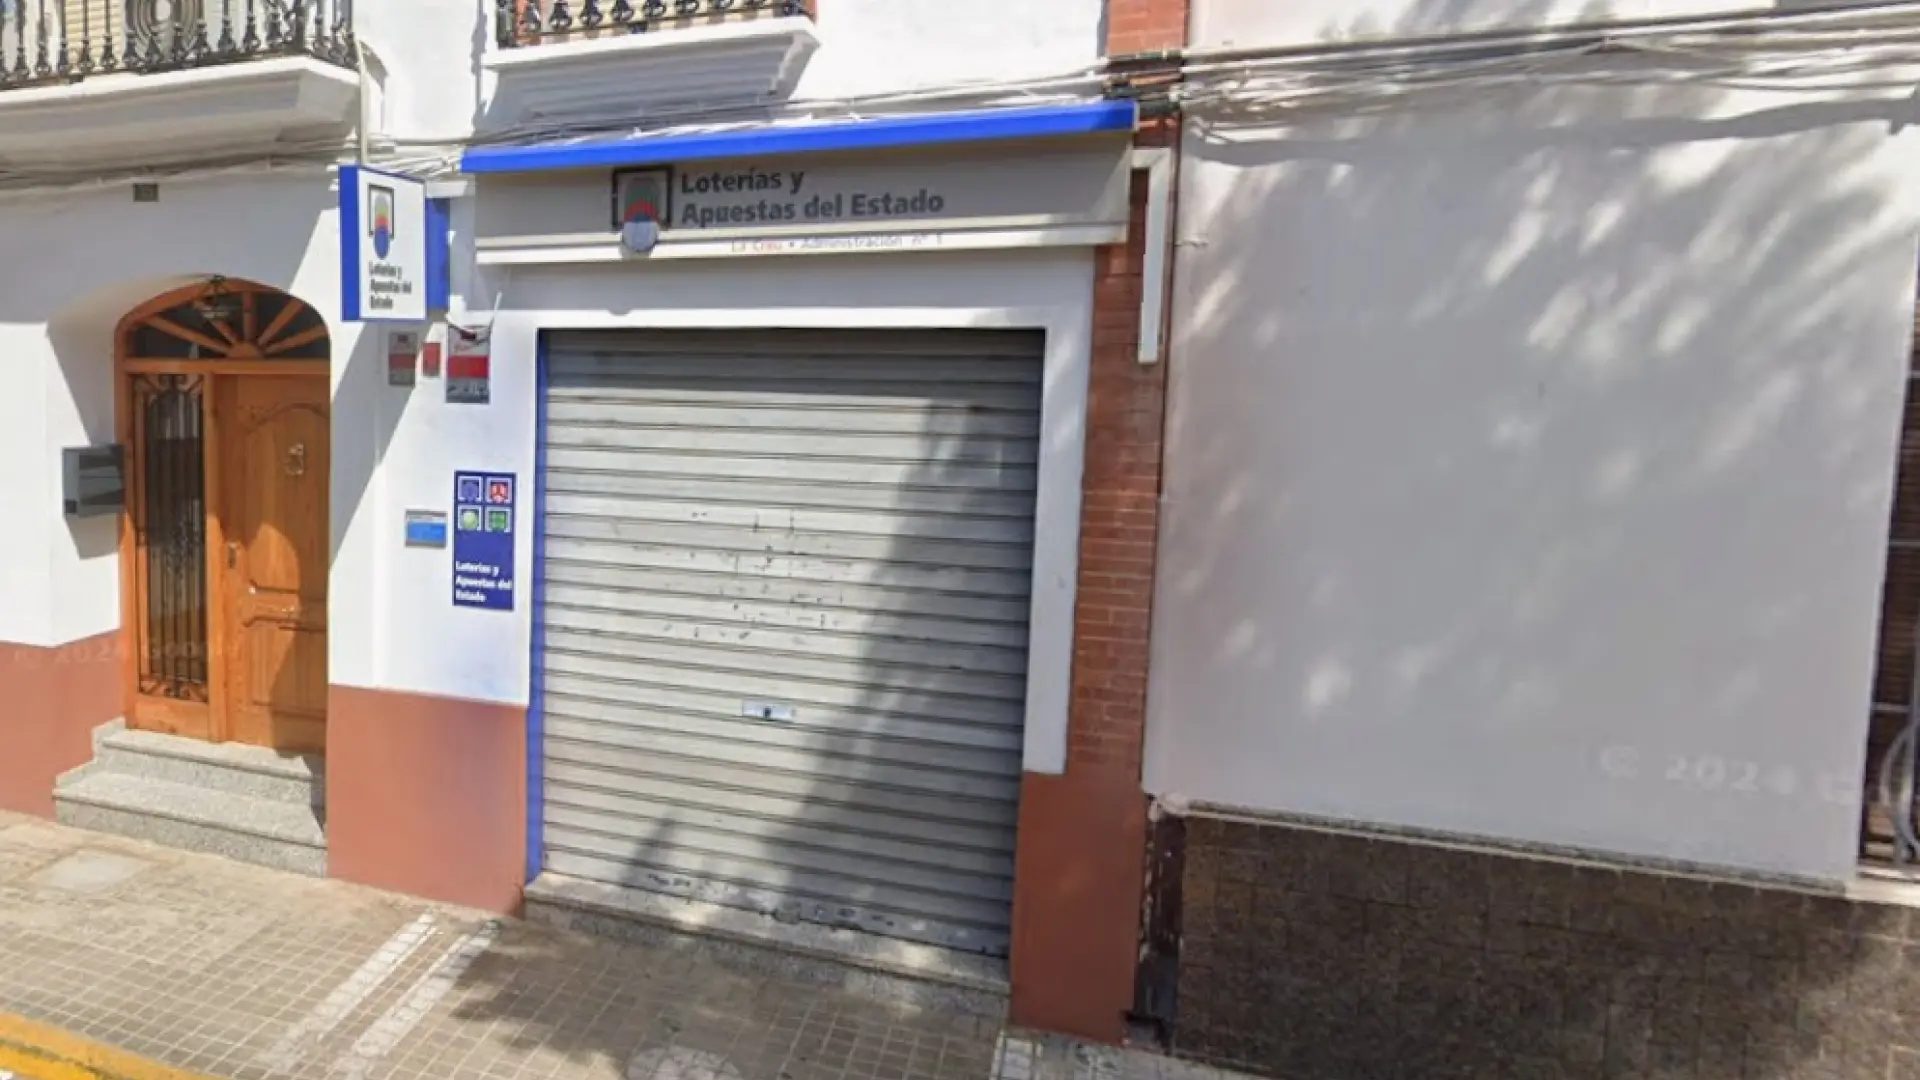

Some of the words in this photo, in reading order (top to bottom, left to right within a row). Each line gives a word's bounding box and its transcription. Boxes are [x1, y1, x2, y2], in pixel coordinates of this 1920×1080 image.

[681, 167, 782, 194] Loterías
[789, 170, 805, 195] y
[681, 200, 796, 228] Apuestas
[804, 193, 843, 218] del
[851, 187, 945, 217] Estado
[370, 295, 393, 310] Estado
[455, 575, 496, 589] Apuestas
[498, 578, 513, 590] del
[455, 589, 486, 602] Estado
